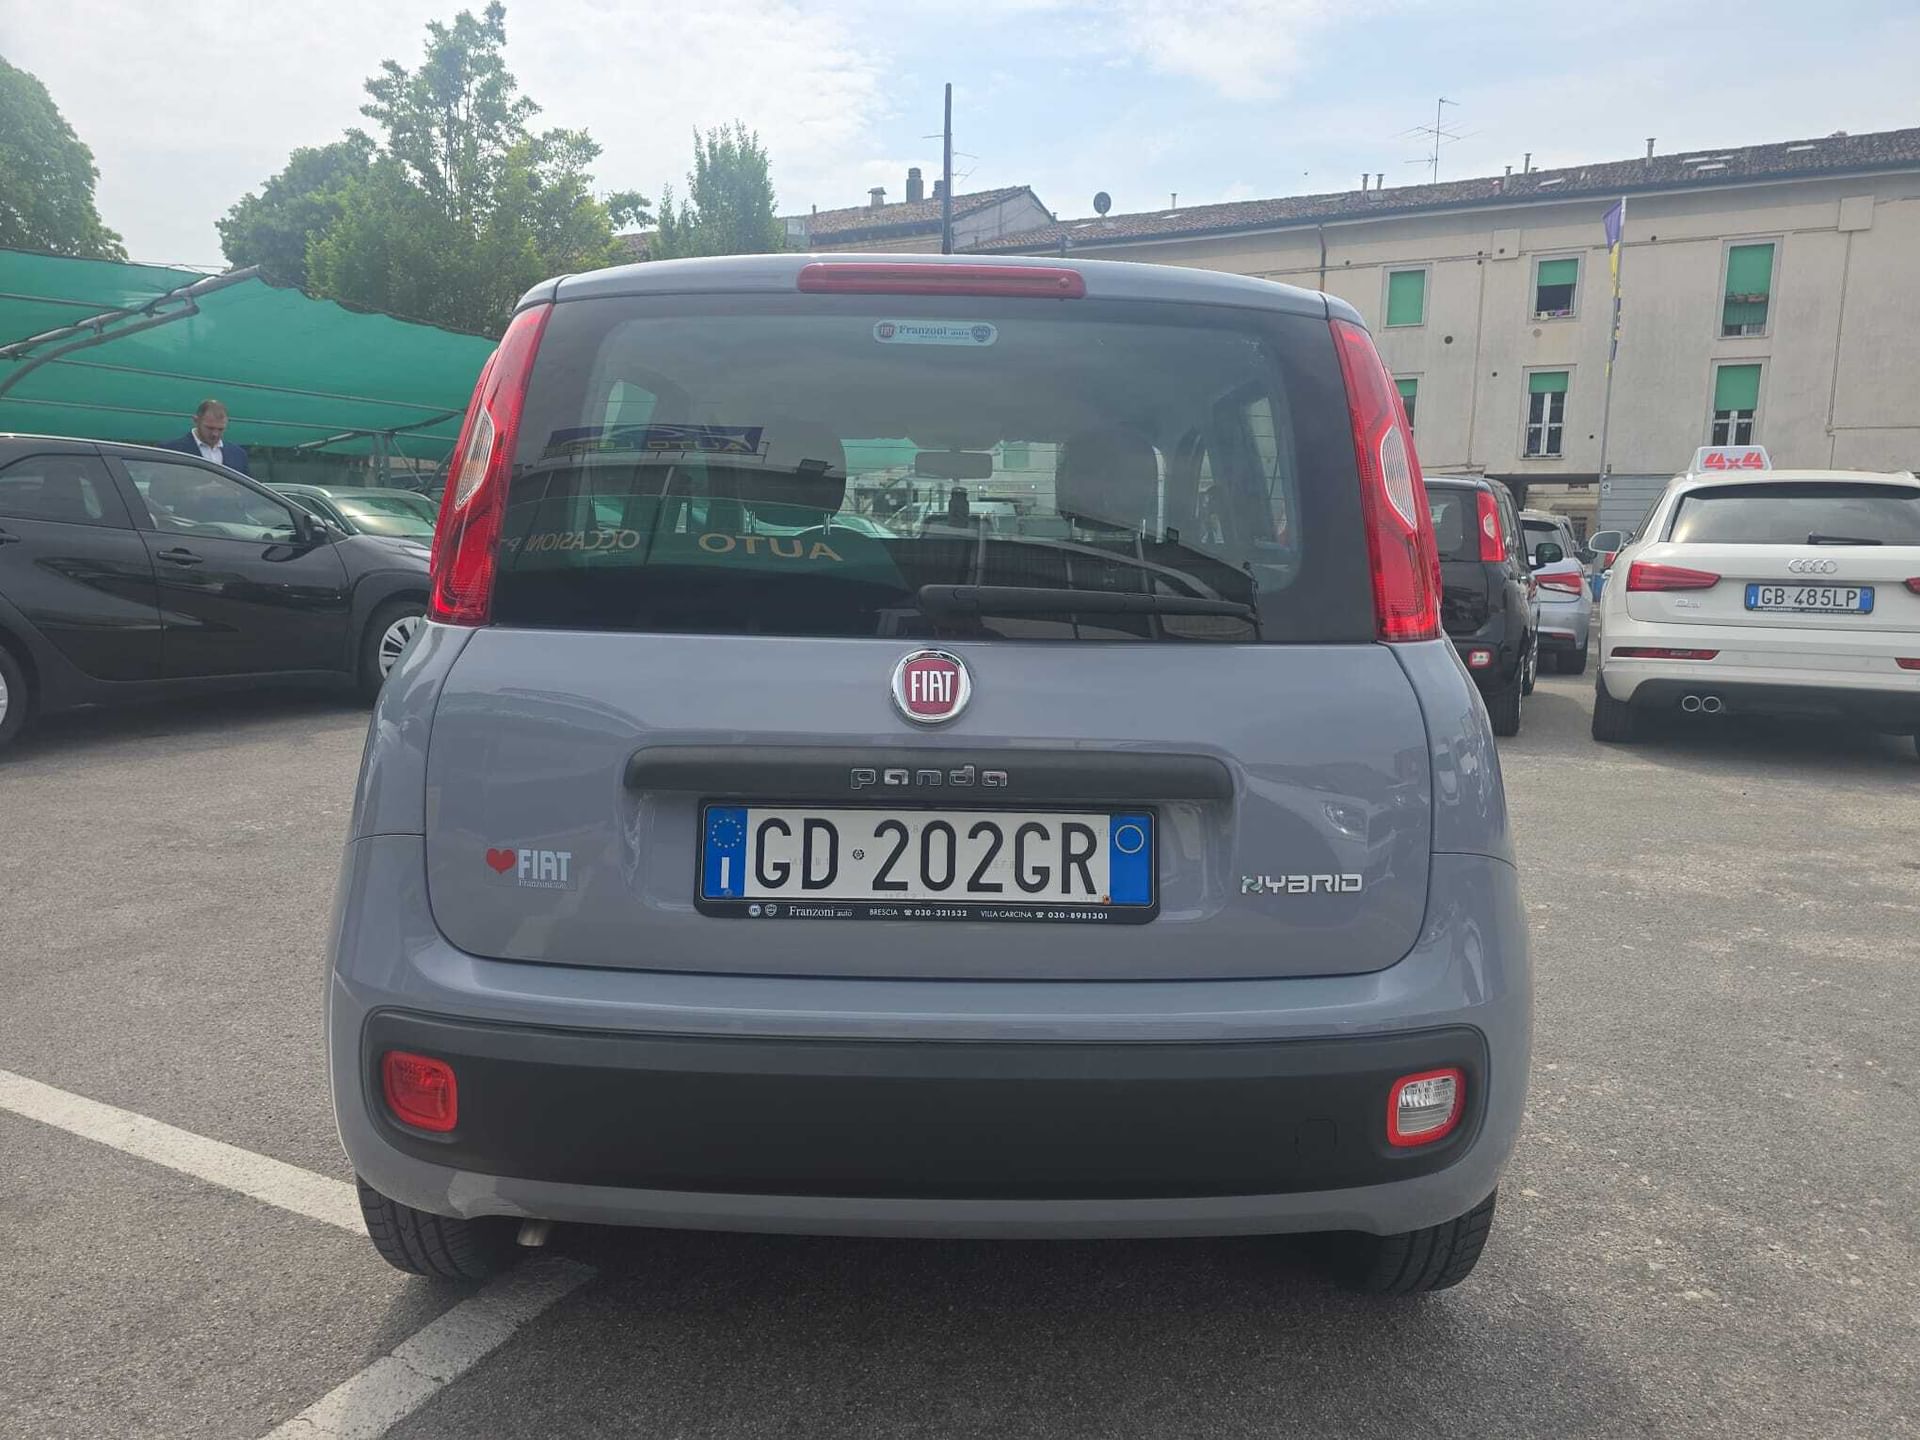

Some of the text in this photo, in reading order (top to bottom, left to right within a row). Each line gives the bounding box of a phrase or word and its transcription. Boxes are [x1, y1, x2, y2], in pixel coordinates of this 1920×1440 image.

[1704, 452, 1764, 470] 4x4
[1761, 588, 1858, 607] GB 485LP
[911, 670, 955, 702] FIAT
[851, 765, 1008, 790] panda
[518, 848, 572, 882] FIAT
[755, 817, 1098, 895] GD 202GR
[1241, 873, 1363, 894] HYBRID
[789, 905, 834, 917] Franzoni
[869, 908, 968, 917] BRESCIA 030-321532
[980, 910, 1108, 920] VILLA CARCINA 030-8981301
